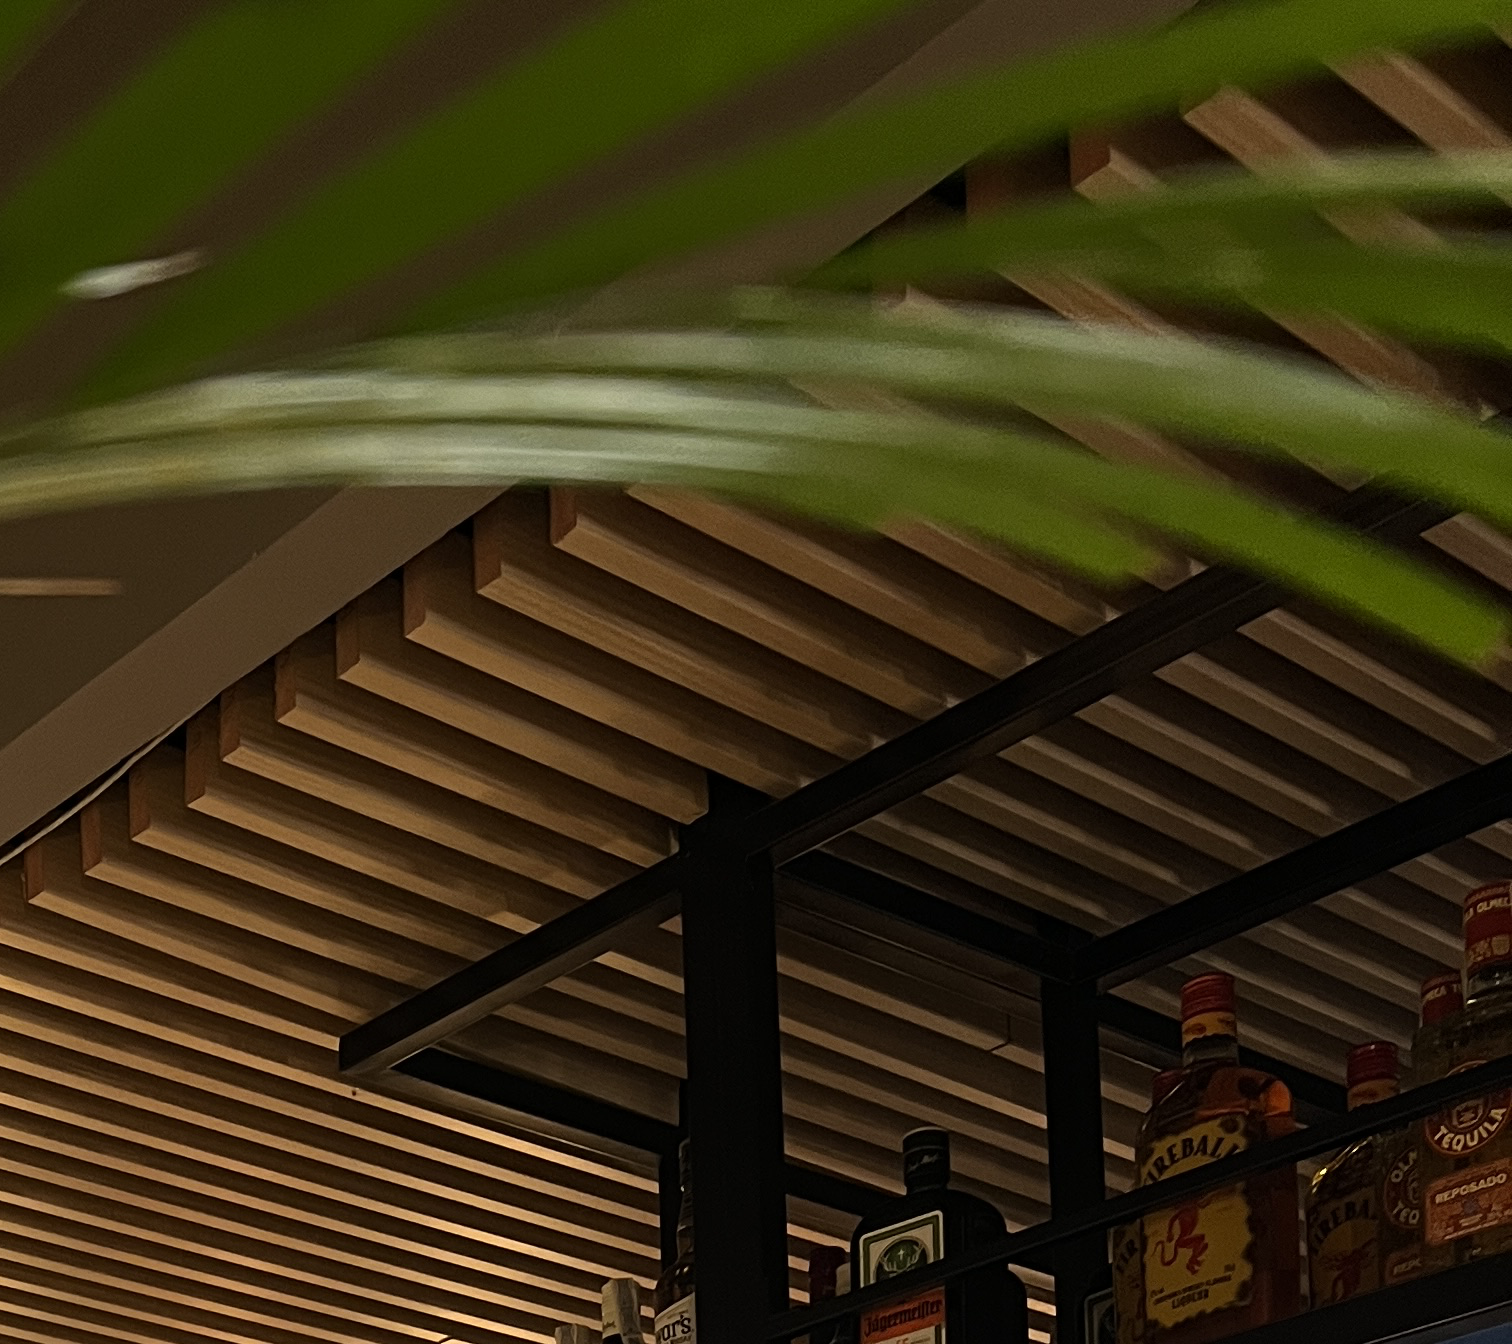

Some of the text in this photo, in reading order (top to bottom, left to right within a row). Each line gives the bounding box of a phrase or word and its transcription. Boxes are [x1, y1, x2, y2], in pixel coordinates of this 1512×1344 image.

[1433, 1107, 1507, 1152] TEQUILA
[1145, 1135, 1241, 1183] IREBAL
[1434, 1173, 1508, 1205] REPOSADO
[863, 1299, 943, 1338] Jägermeister
